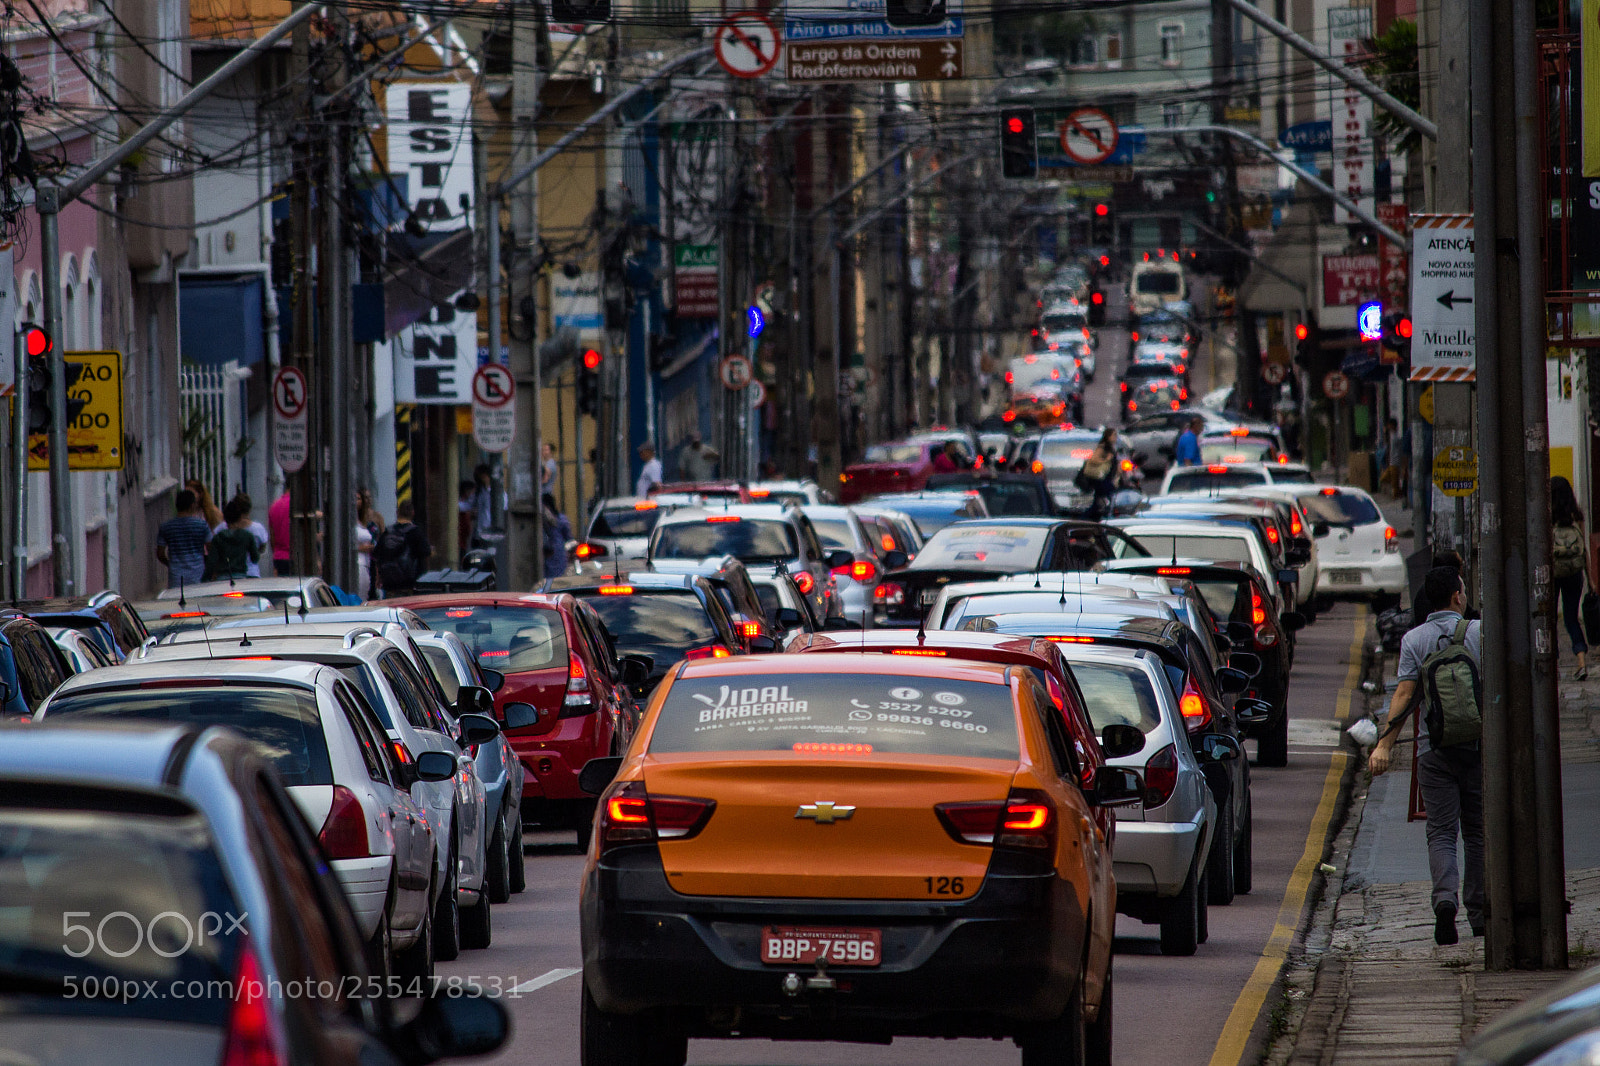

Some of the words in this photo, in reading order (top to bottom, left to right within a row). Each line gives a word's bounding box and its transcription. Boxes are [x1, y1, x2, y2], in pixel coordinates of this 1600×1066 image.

[828, 24, 848, 34] da
[853, 23, 884, 34] Rua
[791, 48, 837, 63] Largo
[842, 46, 862, 60] da
[867, 45, 921, 59] Ordem
[792, 63, 917, 78] Rodoferroviária
[1428, 261, 1451, 269] NOVO
[1453, 261, 1475, 269] ACESS
[1420, 270, 1457, 279] SHOPPING
[692, 685, 794, 708] VIDAL
[699, 700, 809, 723] BARBEARIA
[878, 701, 922, 712] 3527
[927, 706, 973, 718] 5207
[694, 724, 723, 732] BARBA
[877, 713, 934, 726] 99836
[939, 719, 988, 734] 6660
[924, 877, 964, 895] 126
